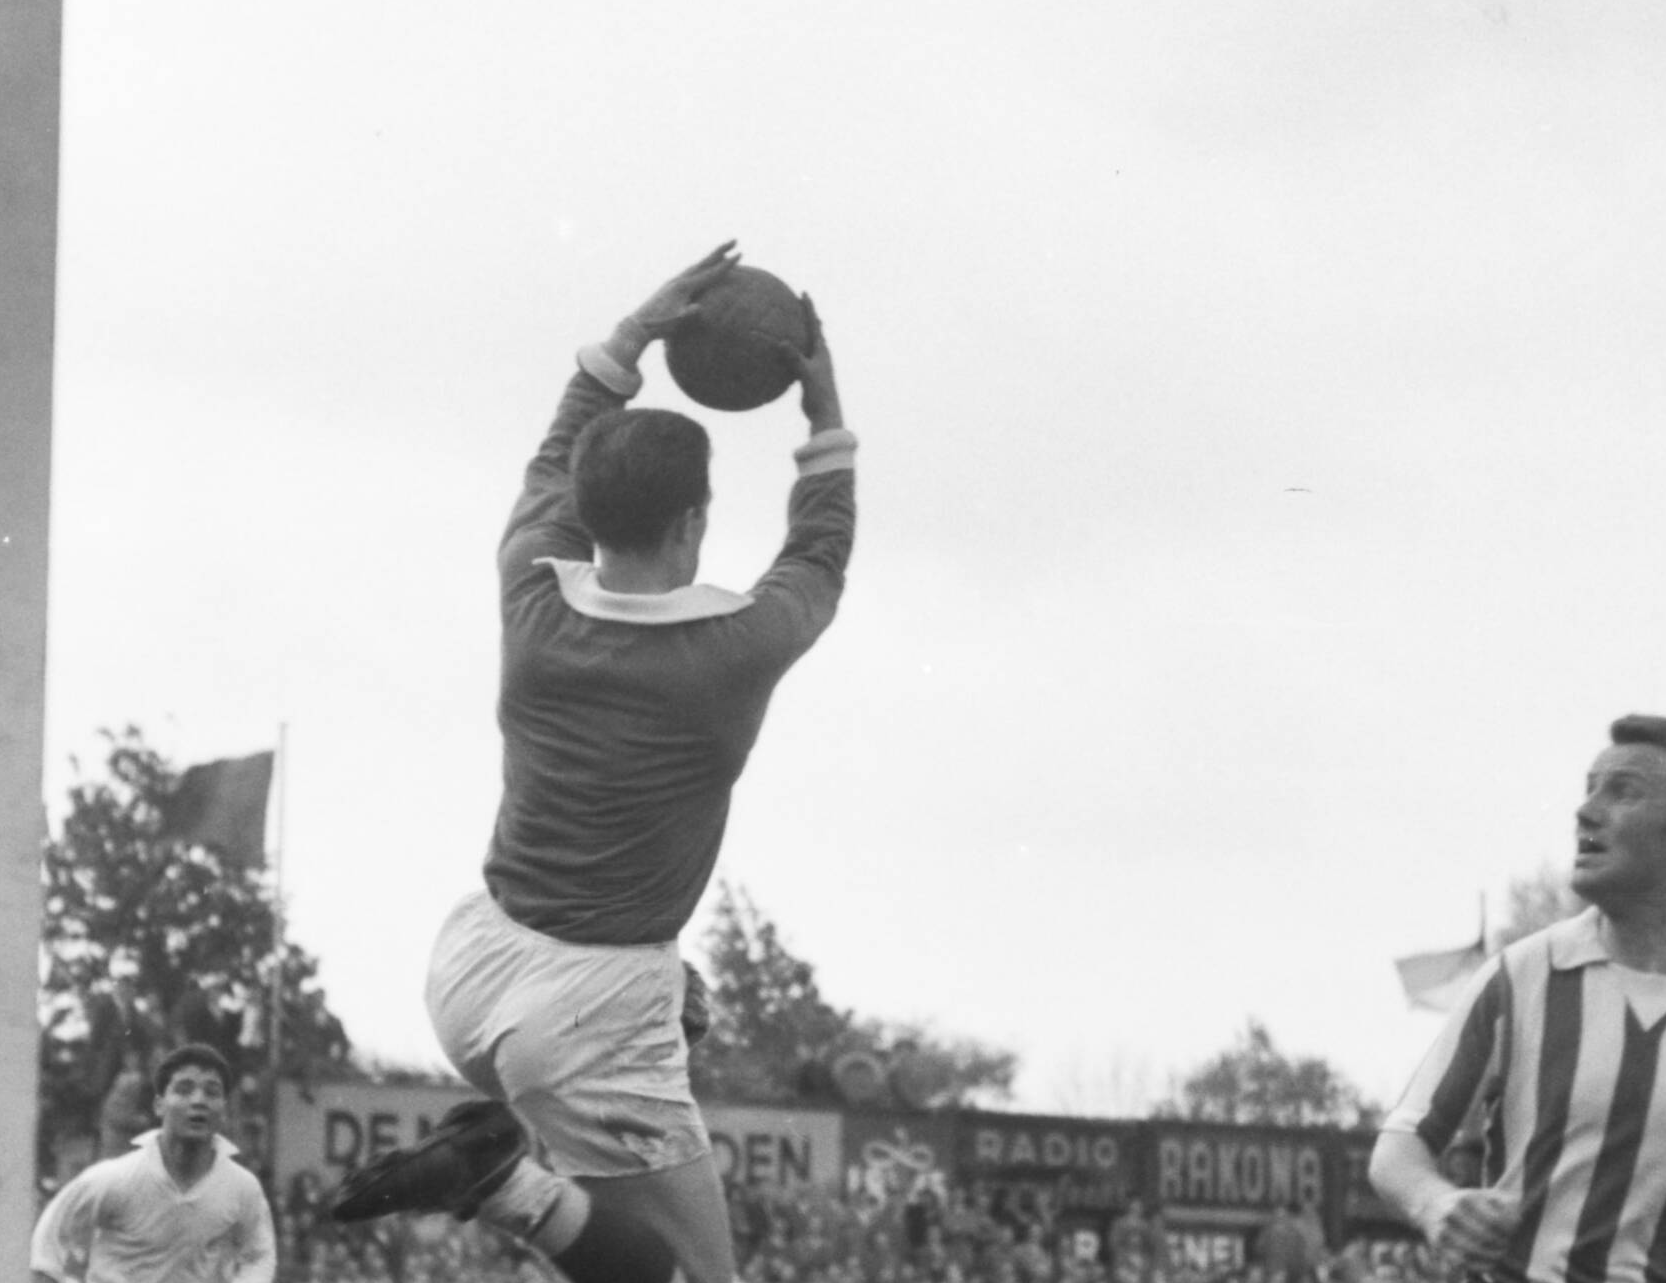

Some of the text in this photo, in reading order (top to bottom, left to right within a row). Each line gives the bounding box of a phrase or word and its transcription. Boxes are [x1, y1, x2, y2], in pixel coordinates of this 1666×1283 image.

[325, 1109, 399, 1166] DE
[976, 1129, 1117, 1168] RADIO
[1159, 1137, 1322, 1207] RAKONA
